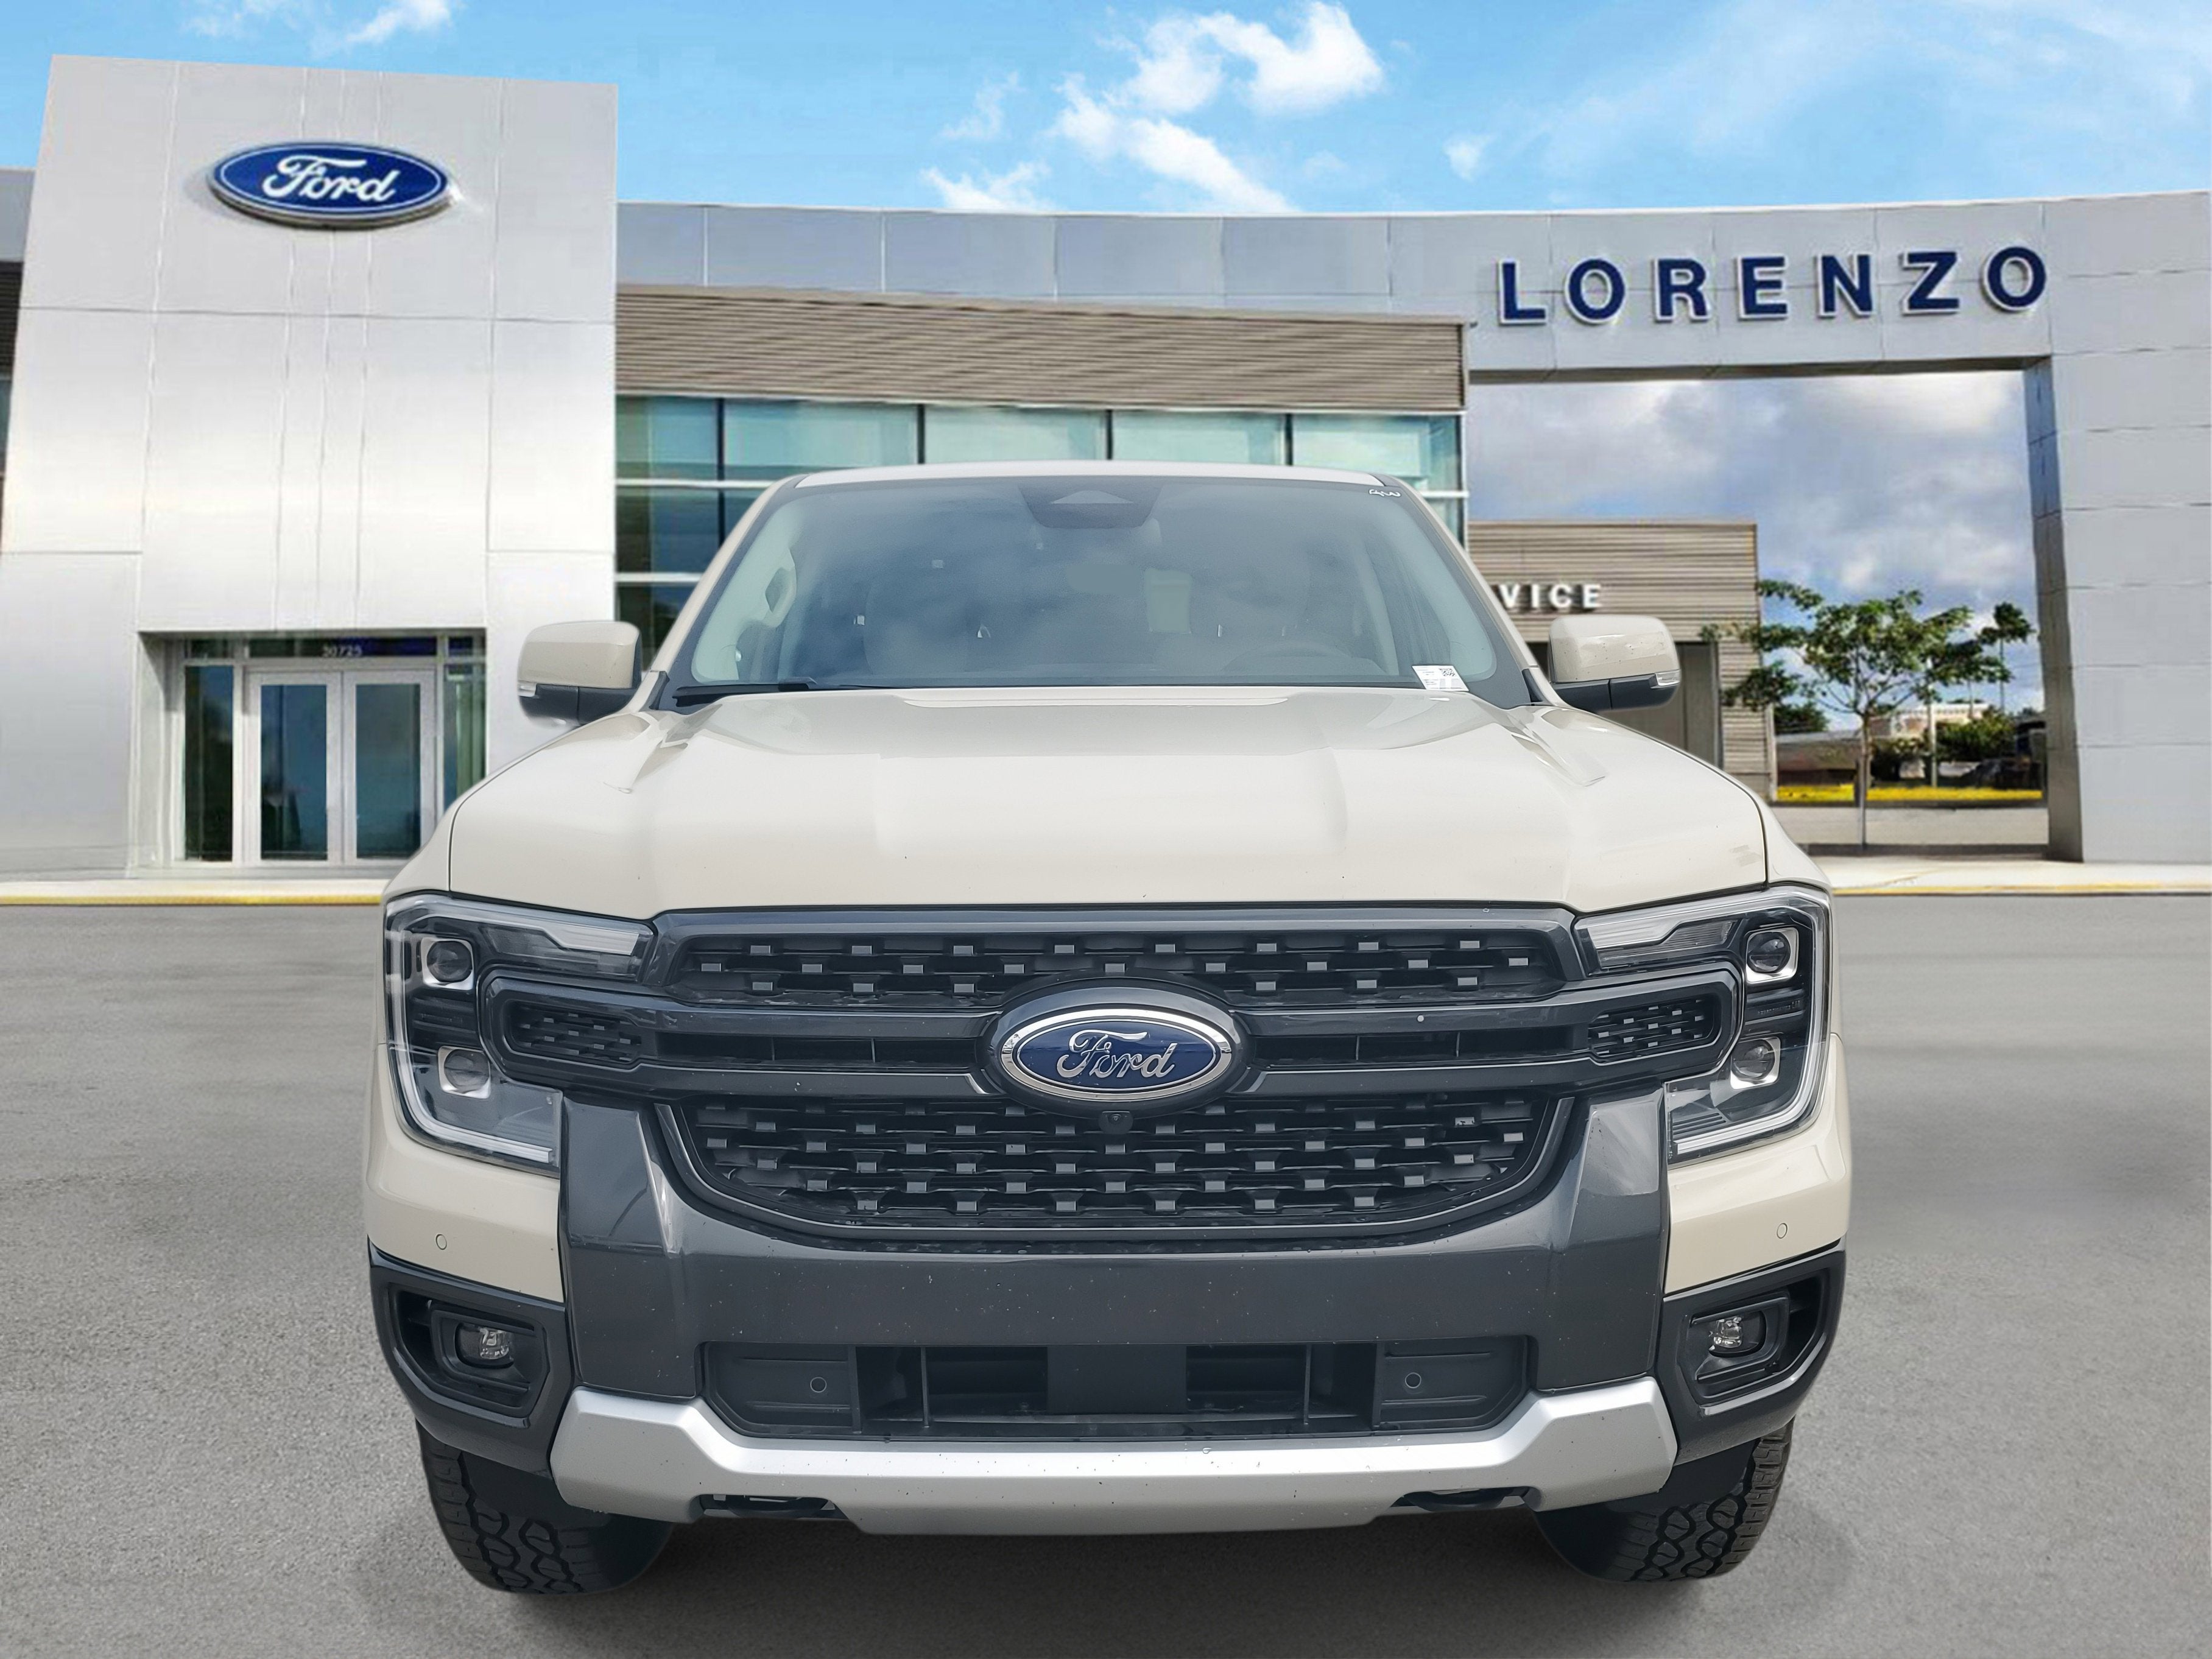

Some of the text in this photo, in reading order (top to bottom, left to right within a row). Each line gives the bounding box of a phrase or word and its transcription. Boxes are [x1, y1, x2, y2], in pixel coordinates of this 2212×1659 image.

[261, 154, 401, 202] Ford
[1499, 245, 2047, 325] LORENZO
[1499, 583, 1602, 608] VICE
[1057, 1029, 1178, 1079] Ford
